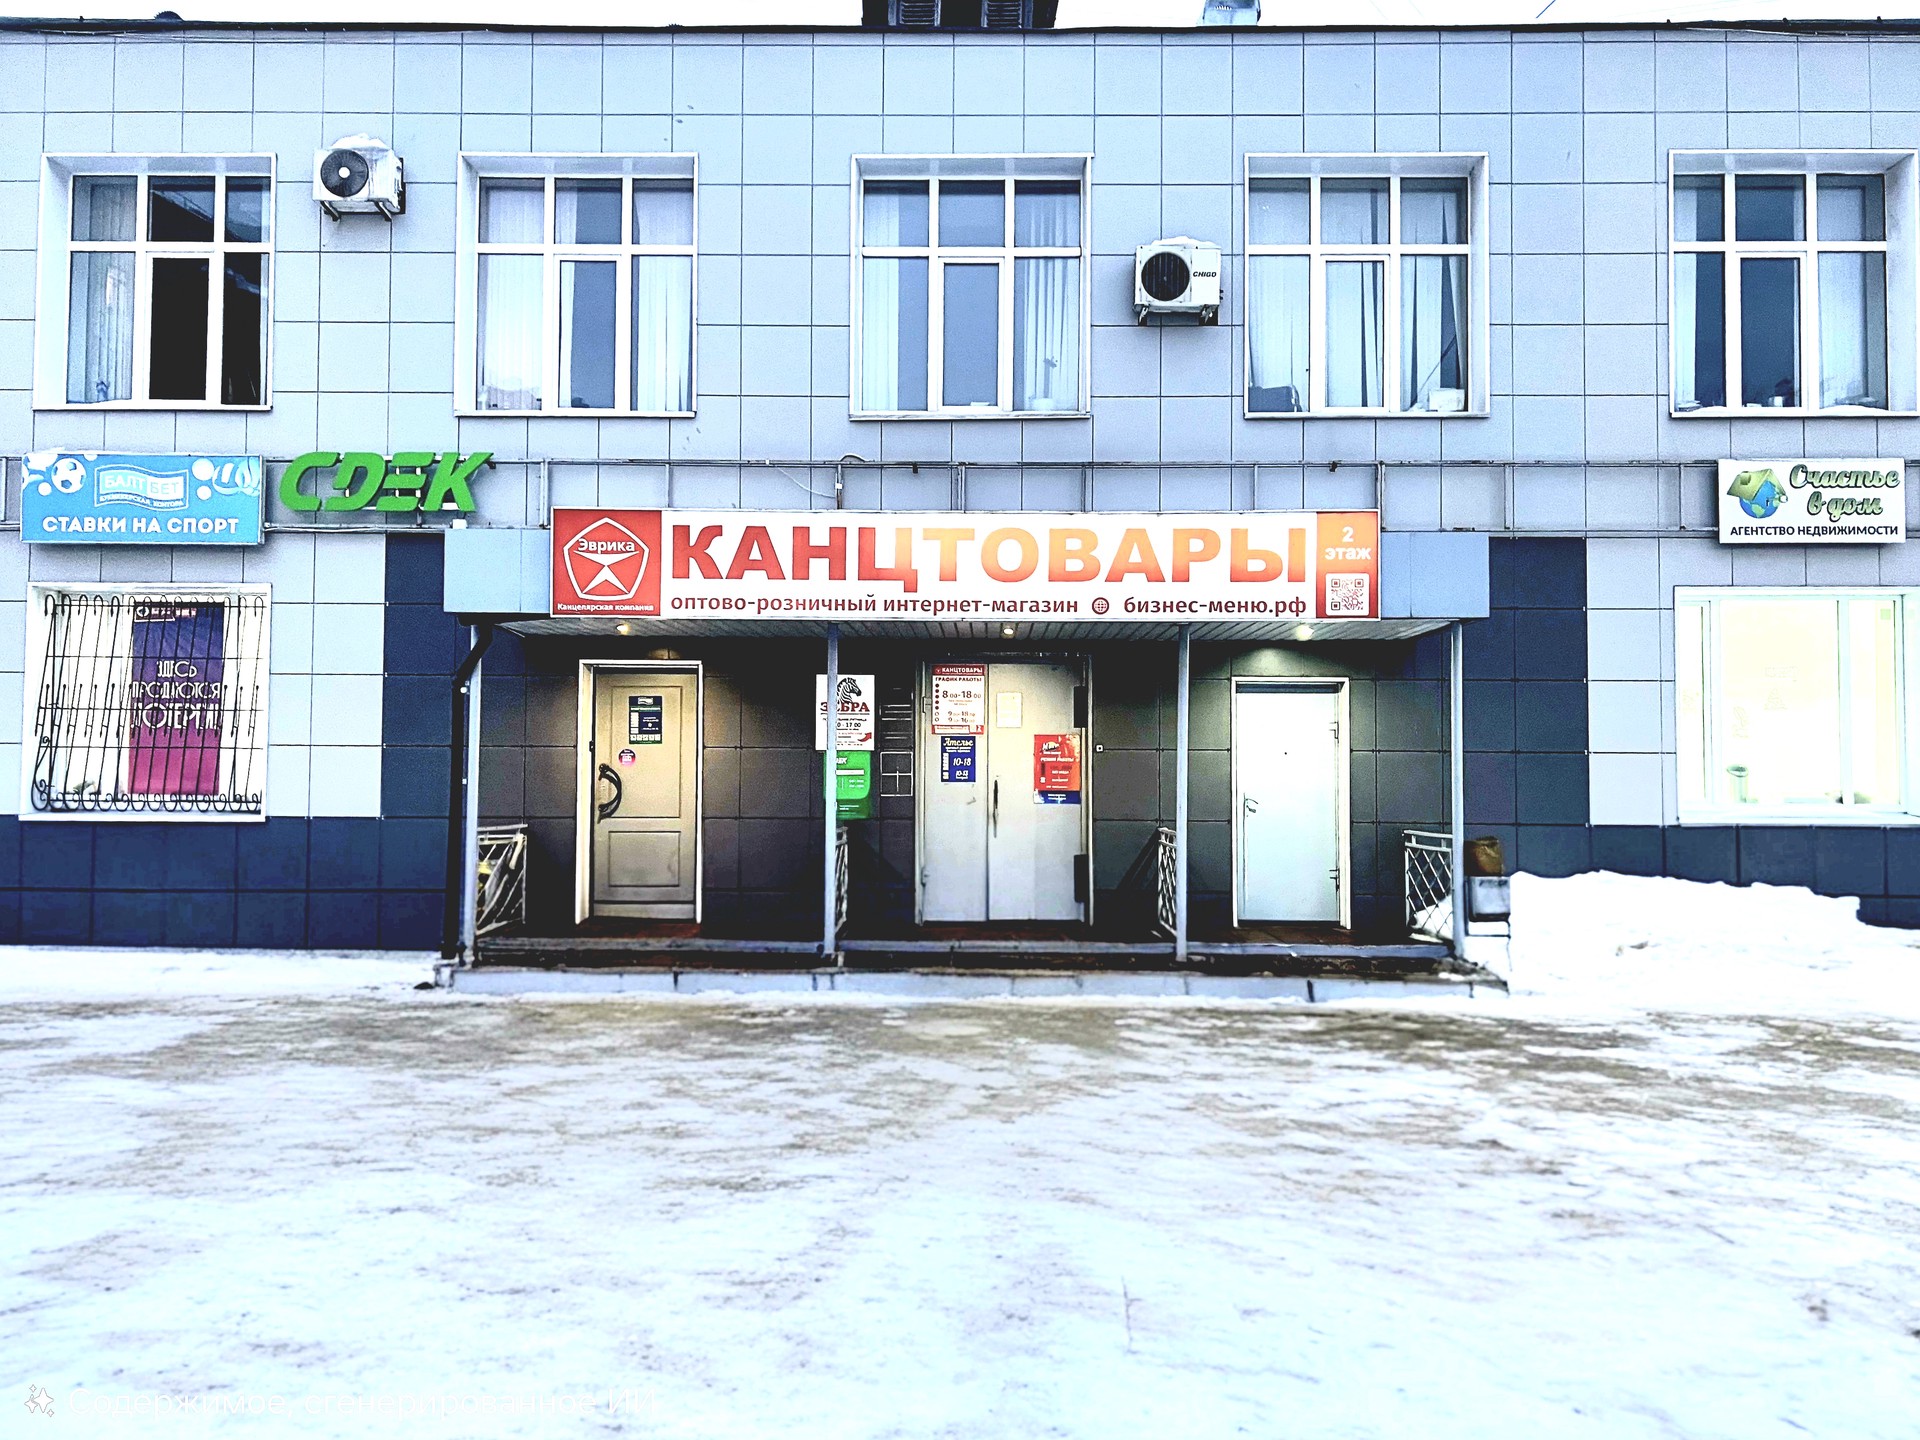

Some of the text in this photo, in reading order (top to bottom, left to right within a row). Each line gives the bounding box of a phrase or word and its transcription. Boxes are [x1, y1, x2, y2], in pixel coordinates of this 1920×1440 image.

[1790, 464, 1901, 489] Счастье
[1807, 491, 1884, 522] в дом
[43, 516, 239, 534] СТАВКИ НА СПОРТ
[1730, 526, 1899, 537] АГЕНТСТВО НЕДВИЖИМОСТИ
[1342, 526, 1354, 542] 2
[578, 538, 635, 554] Эврика
[1325, 547, 1371, 560] этаж
[672, 525, 1306, 593] КАНЦТОВАРЫ
[557, 603, 613, 611] Канцелярская
[671, 594, 1307, 617] оптово-розничный интернет-магазин бизнес-меню.рф
[953, 757, 972, 766] 10-18
